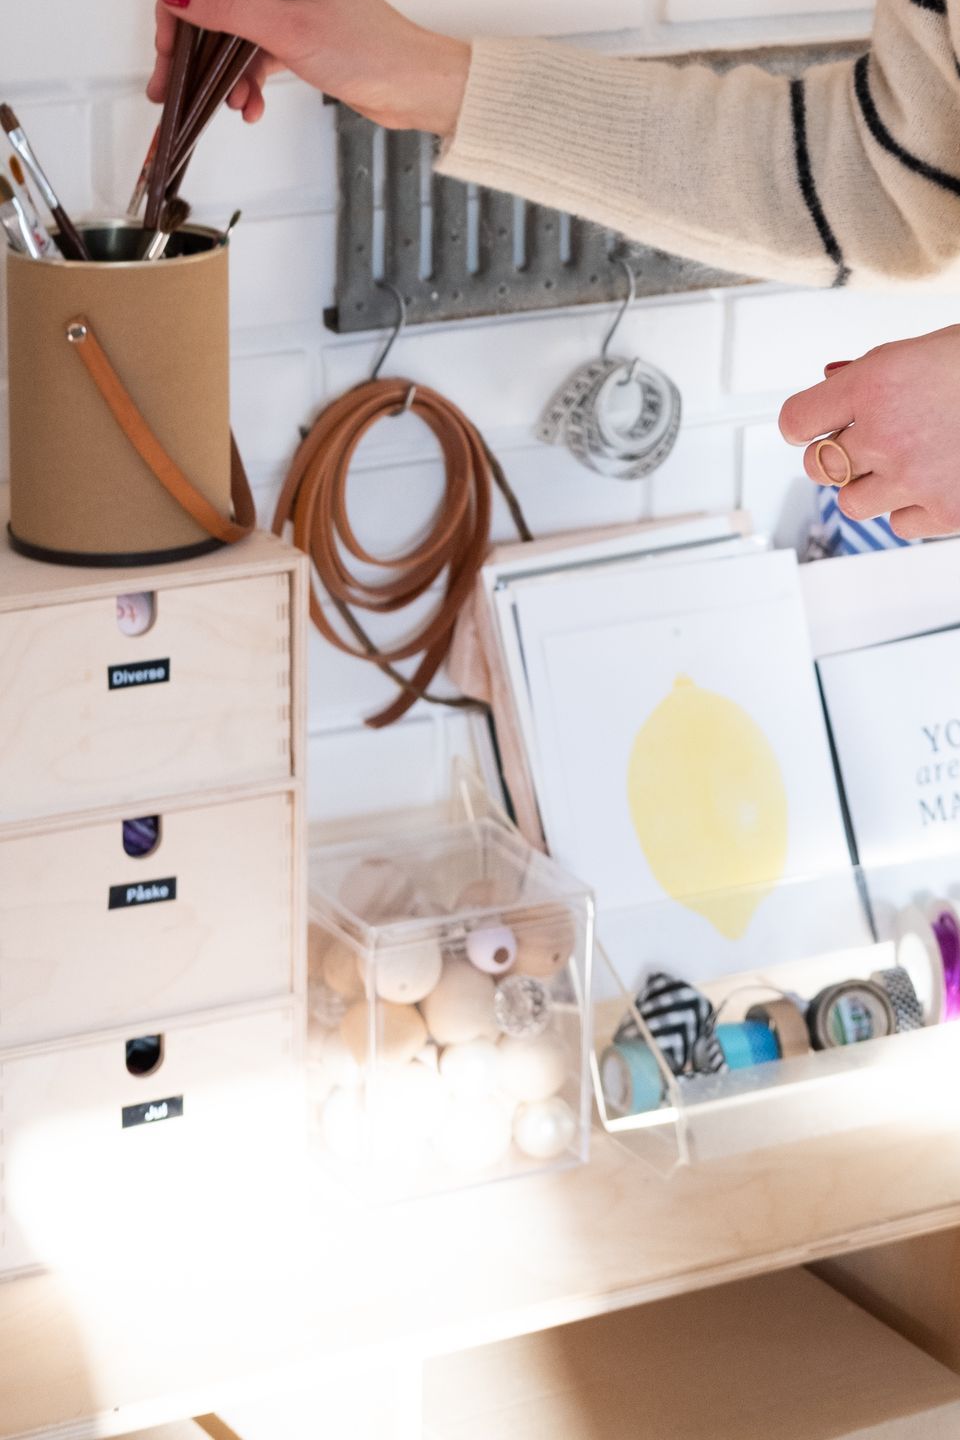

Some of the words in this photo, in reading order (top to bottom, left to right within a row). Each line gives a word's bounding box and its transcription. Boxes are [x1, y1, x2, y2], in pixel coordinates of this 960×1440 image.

[112, 666, 166, 686] Diverse
[916, 758, 960, 786] are
[126, 884, 169, 903] Påske
